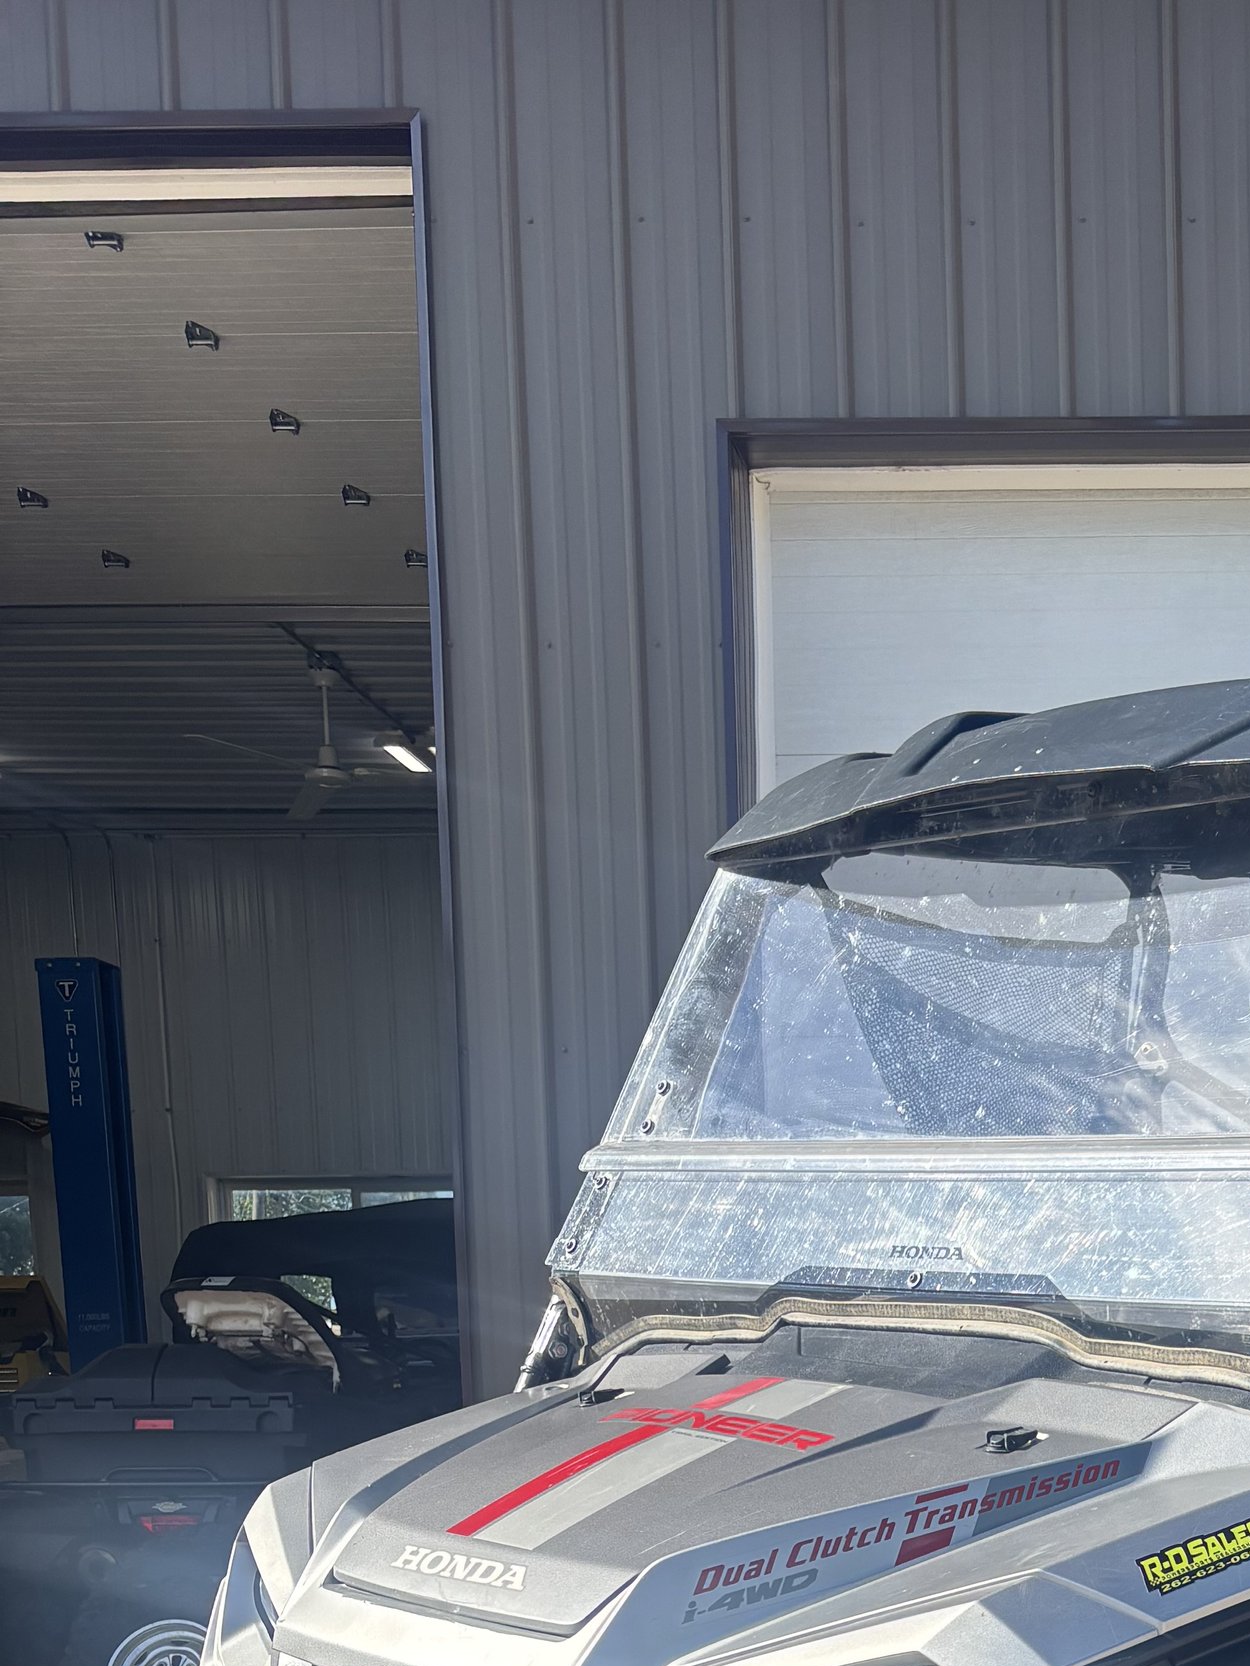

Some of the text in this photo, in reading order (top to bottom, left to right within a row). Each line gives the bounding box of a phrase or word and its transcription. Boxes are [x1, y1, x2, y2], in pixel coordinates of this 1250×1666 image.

[63, 1008, 83, 1107] TRIUMPH
[889, 1245, 964, 1261] HONDA
[598, 1408, 836, 1452] PIONEER
[692, 1459, 1120, 1596] Dual Clutch Transmission
[390, 1545, 527, 1591] HONDA
[681, 1568, 819, 1625] i-4WD
